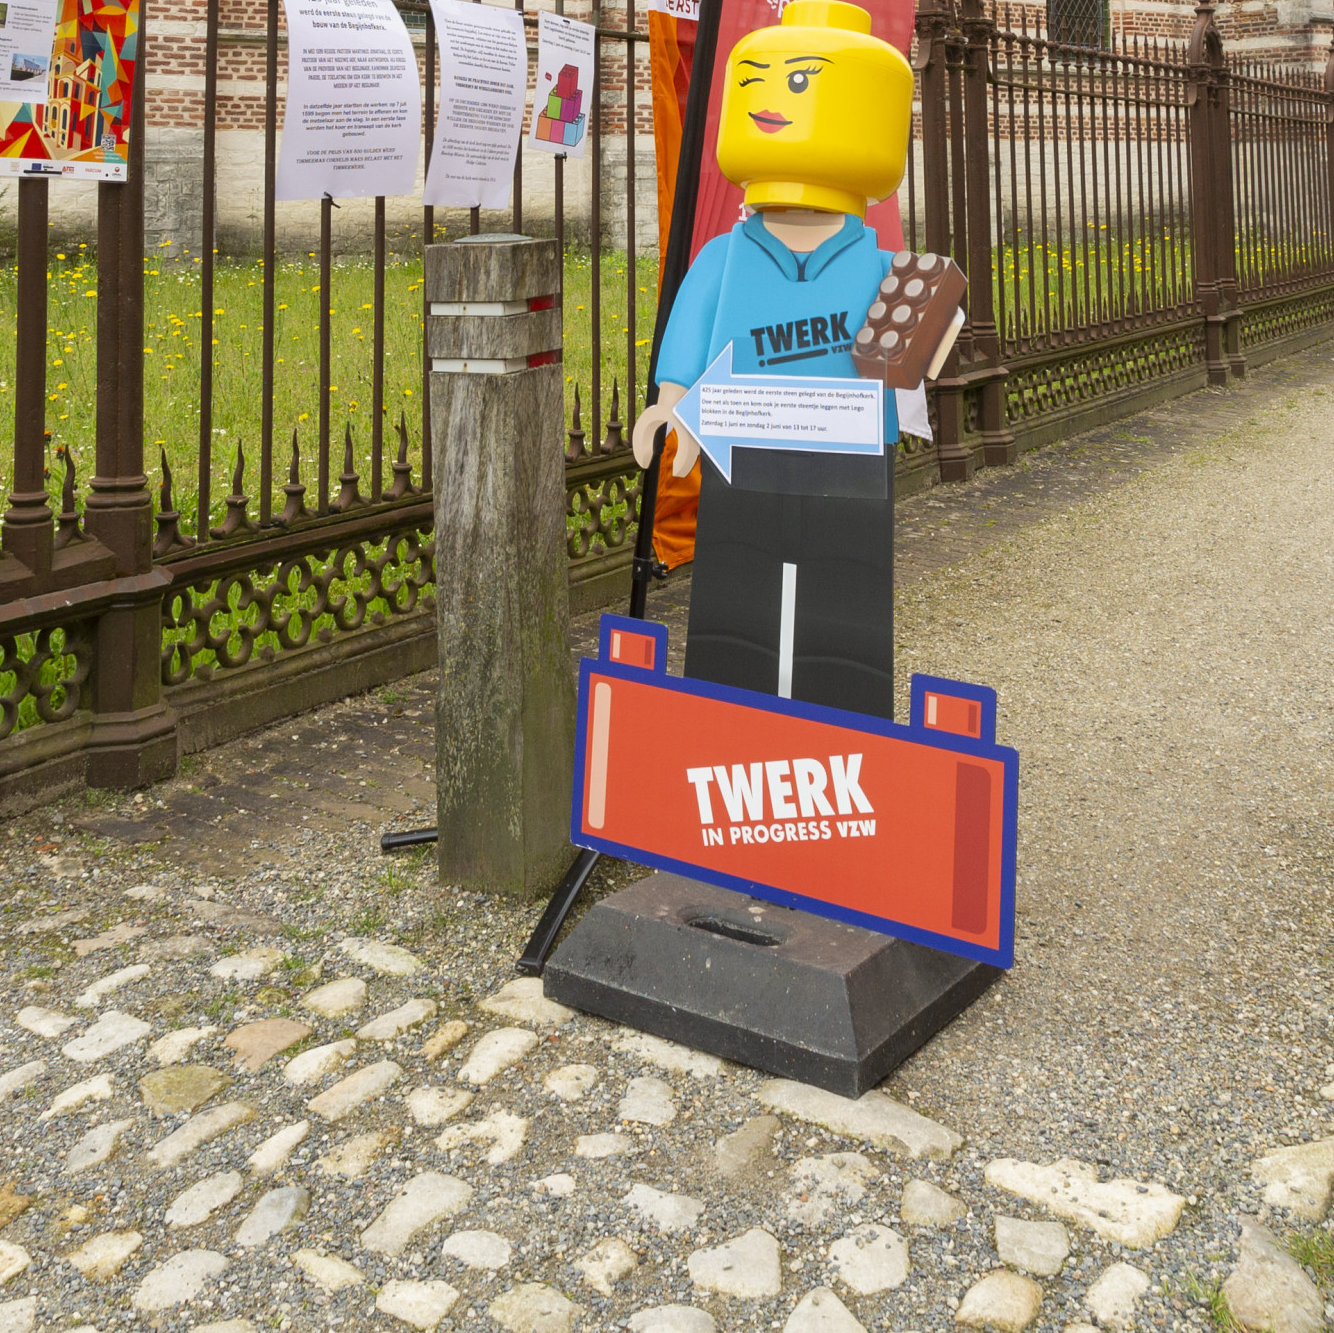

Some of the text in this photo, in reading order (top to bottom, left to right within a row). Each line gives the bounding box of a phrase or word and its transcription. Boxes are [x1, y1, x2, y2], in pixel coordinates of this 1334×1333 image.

[750, 311, 851, 356] TWERK
[836, 392, 875, 400] Begijnhofkerk.
[736, 409, 773, 418] Begijnhofkerk.
[771, 423, 781, 431] juni
[686, 752, 874, 825] TWERK
[702, 819, 877, 847] IN PROGRESS VZW
